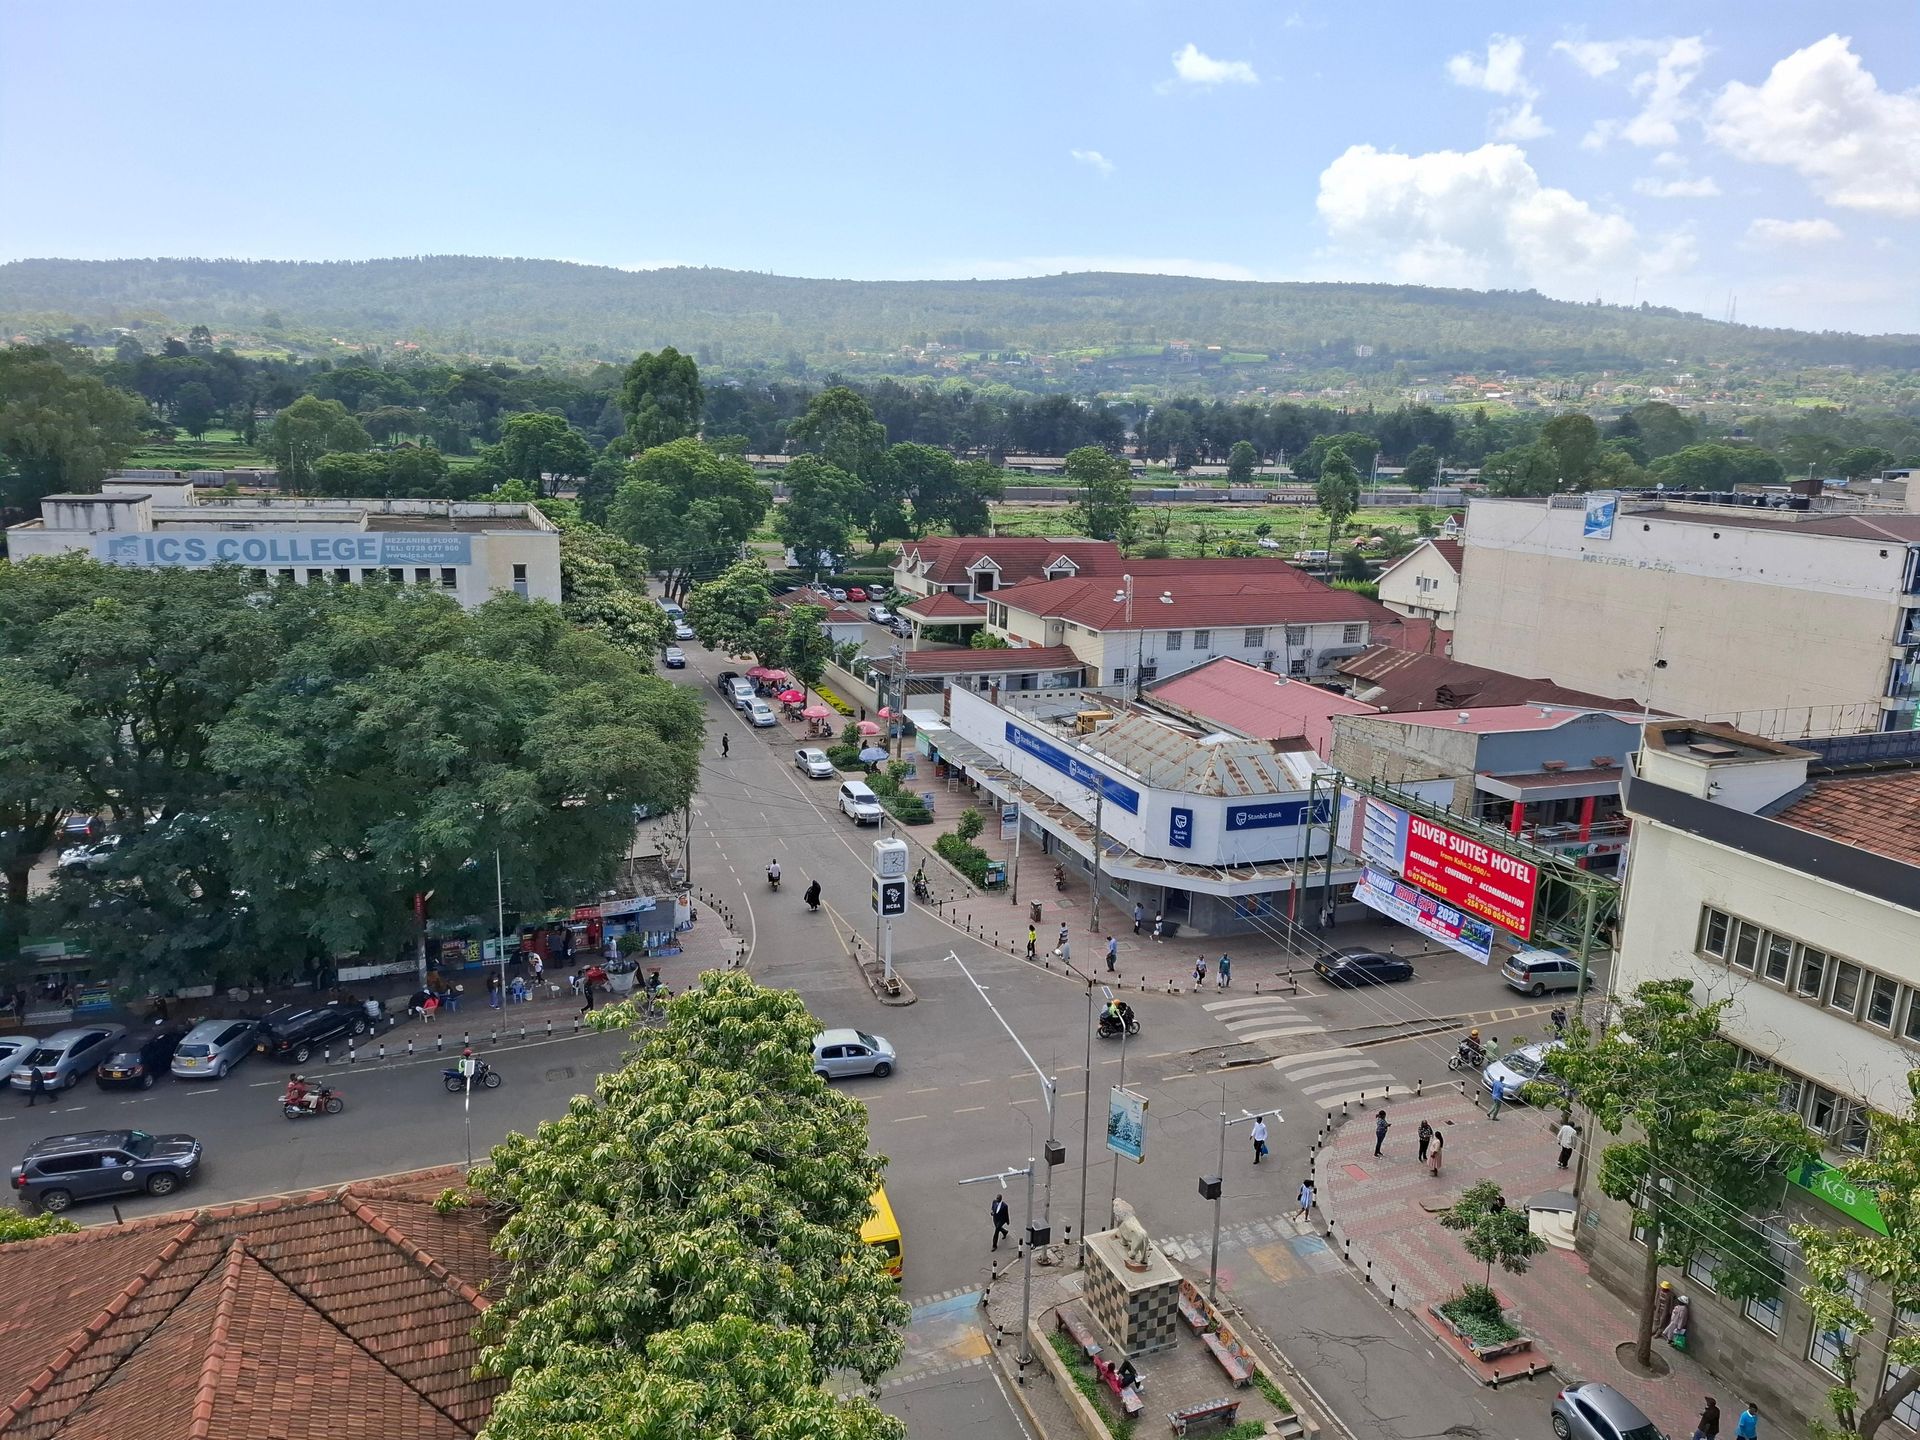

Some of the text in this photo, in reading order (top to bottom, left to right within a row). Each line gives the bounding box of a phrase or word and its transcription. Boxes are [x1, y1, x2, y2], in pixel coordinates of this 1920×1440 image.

[117, 544, 138, 556] ICS
[145, 538, 377, 562] ICS COLLEGE
[384, 537, 431, 545] MEZZANINE
[1076, 766, 1091, 779] Stanbic
[1248, 811, 1282, 821] Stanbic Bank
[1411, 819, 1530, 884] SILVER SUITES HOTEL
[1410, 850, 1525, 909] RESTAURANT CONFERENCE ACCOMMODATION
[1366, 870, 1395, 894] NAKURU
[1394, 884, 1418, 906] TRADE
[1417, 895, 1438, 915] EXPO
[1437, 905, 1460, 926] 2025
[1822, 1176, 1856, 1206] KCB
